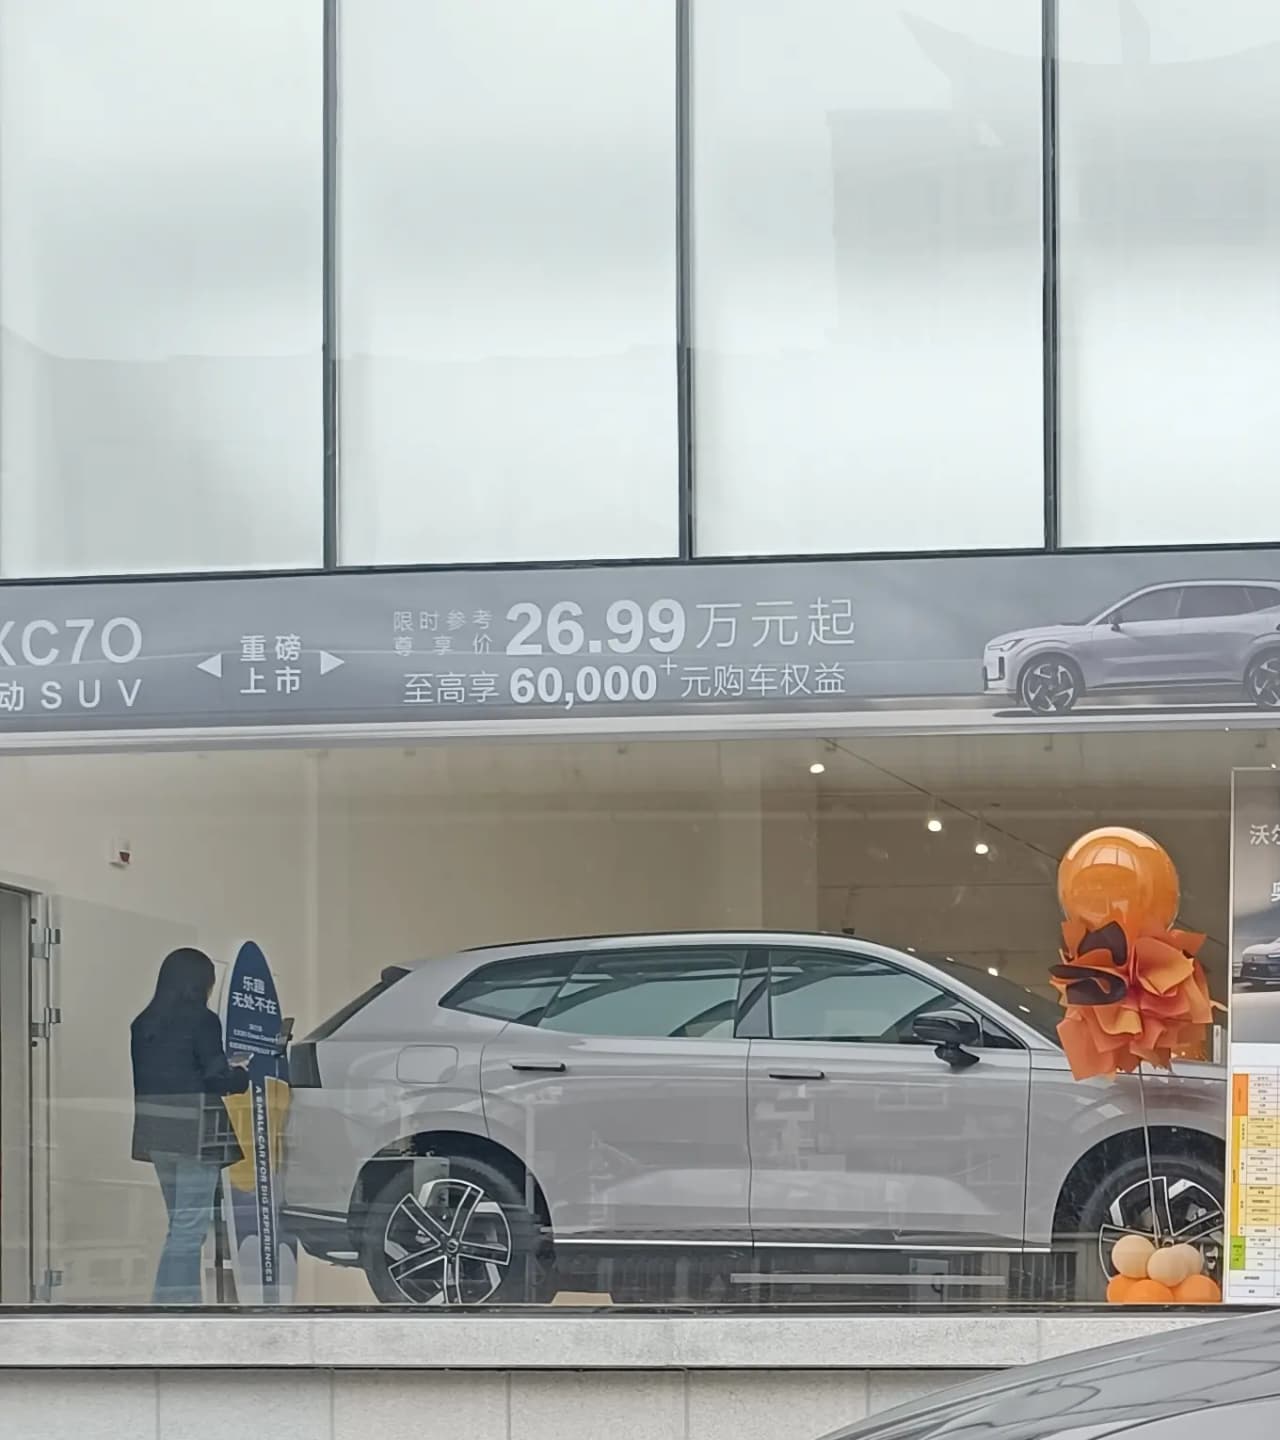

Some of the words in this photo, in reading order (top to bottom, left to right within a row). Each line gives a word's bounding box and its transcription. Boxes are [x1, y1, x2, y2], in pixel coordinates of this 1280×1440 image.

[240, 633, 302, 661] 重磅
[240, 666, 302, 694] 上市
[231, 991, 278, 1016] 无处不在
